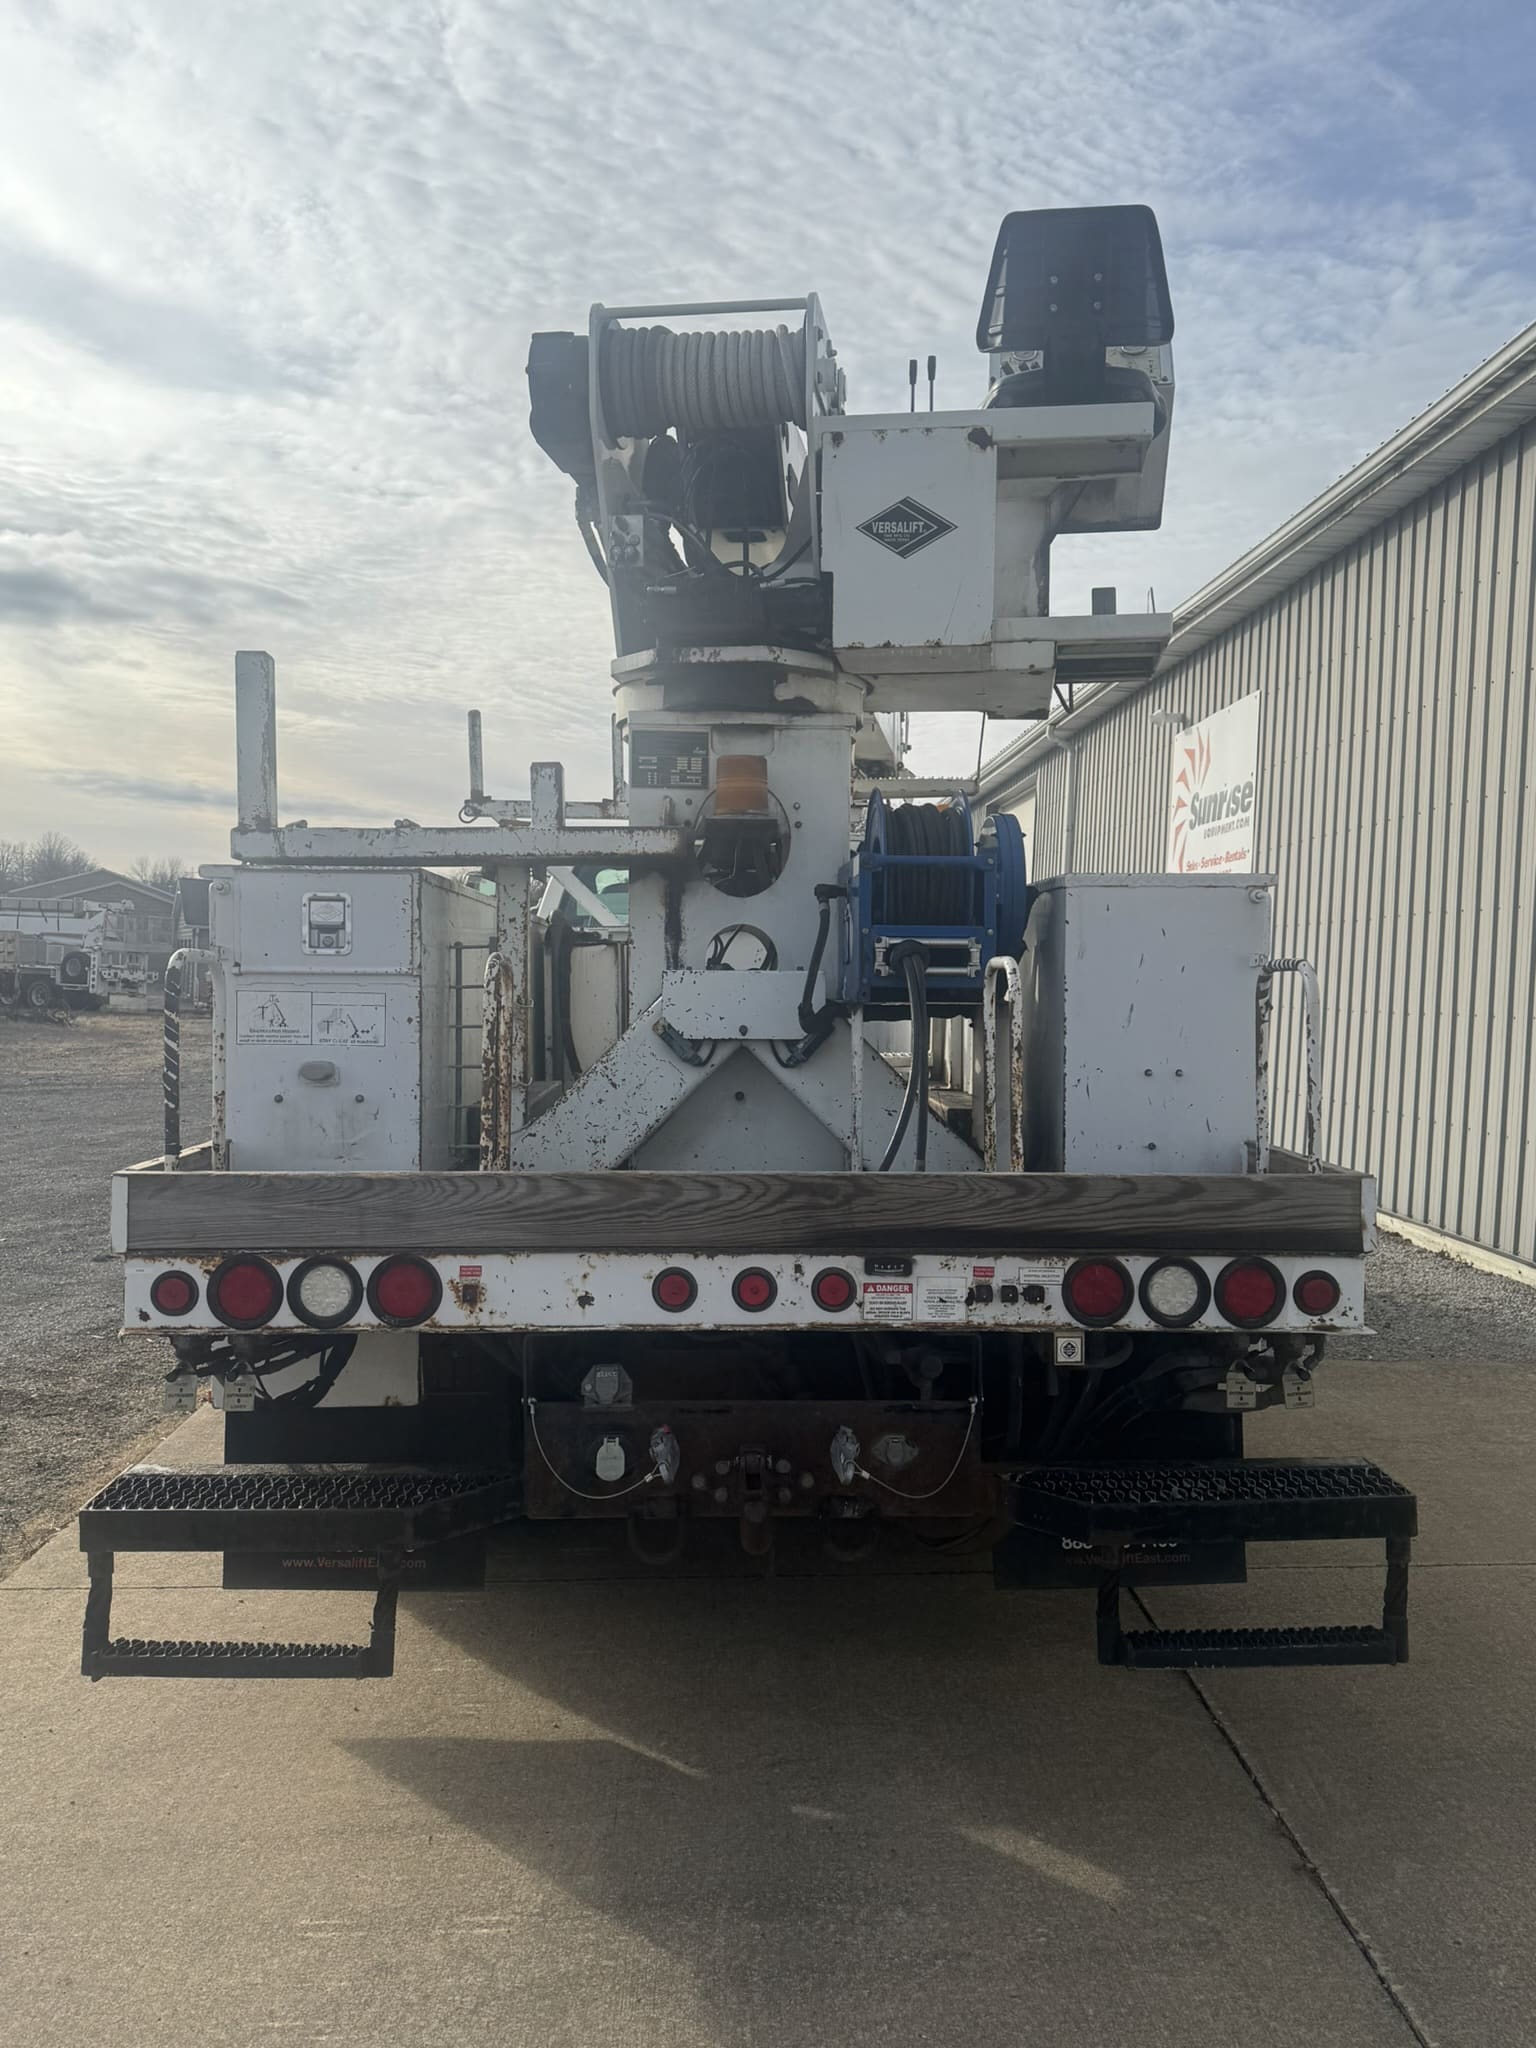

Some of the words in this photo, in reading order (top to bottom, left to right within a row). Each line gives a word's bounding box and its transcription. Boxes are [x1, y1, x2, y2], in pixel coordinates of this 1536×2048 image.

[872, 521, 925, 534] VERSALIFT
[1189, 781, 1253, 830] Sunrise
[876, 1284, 910, 1293] DANGER
